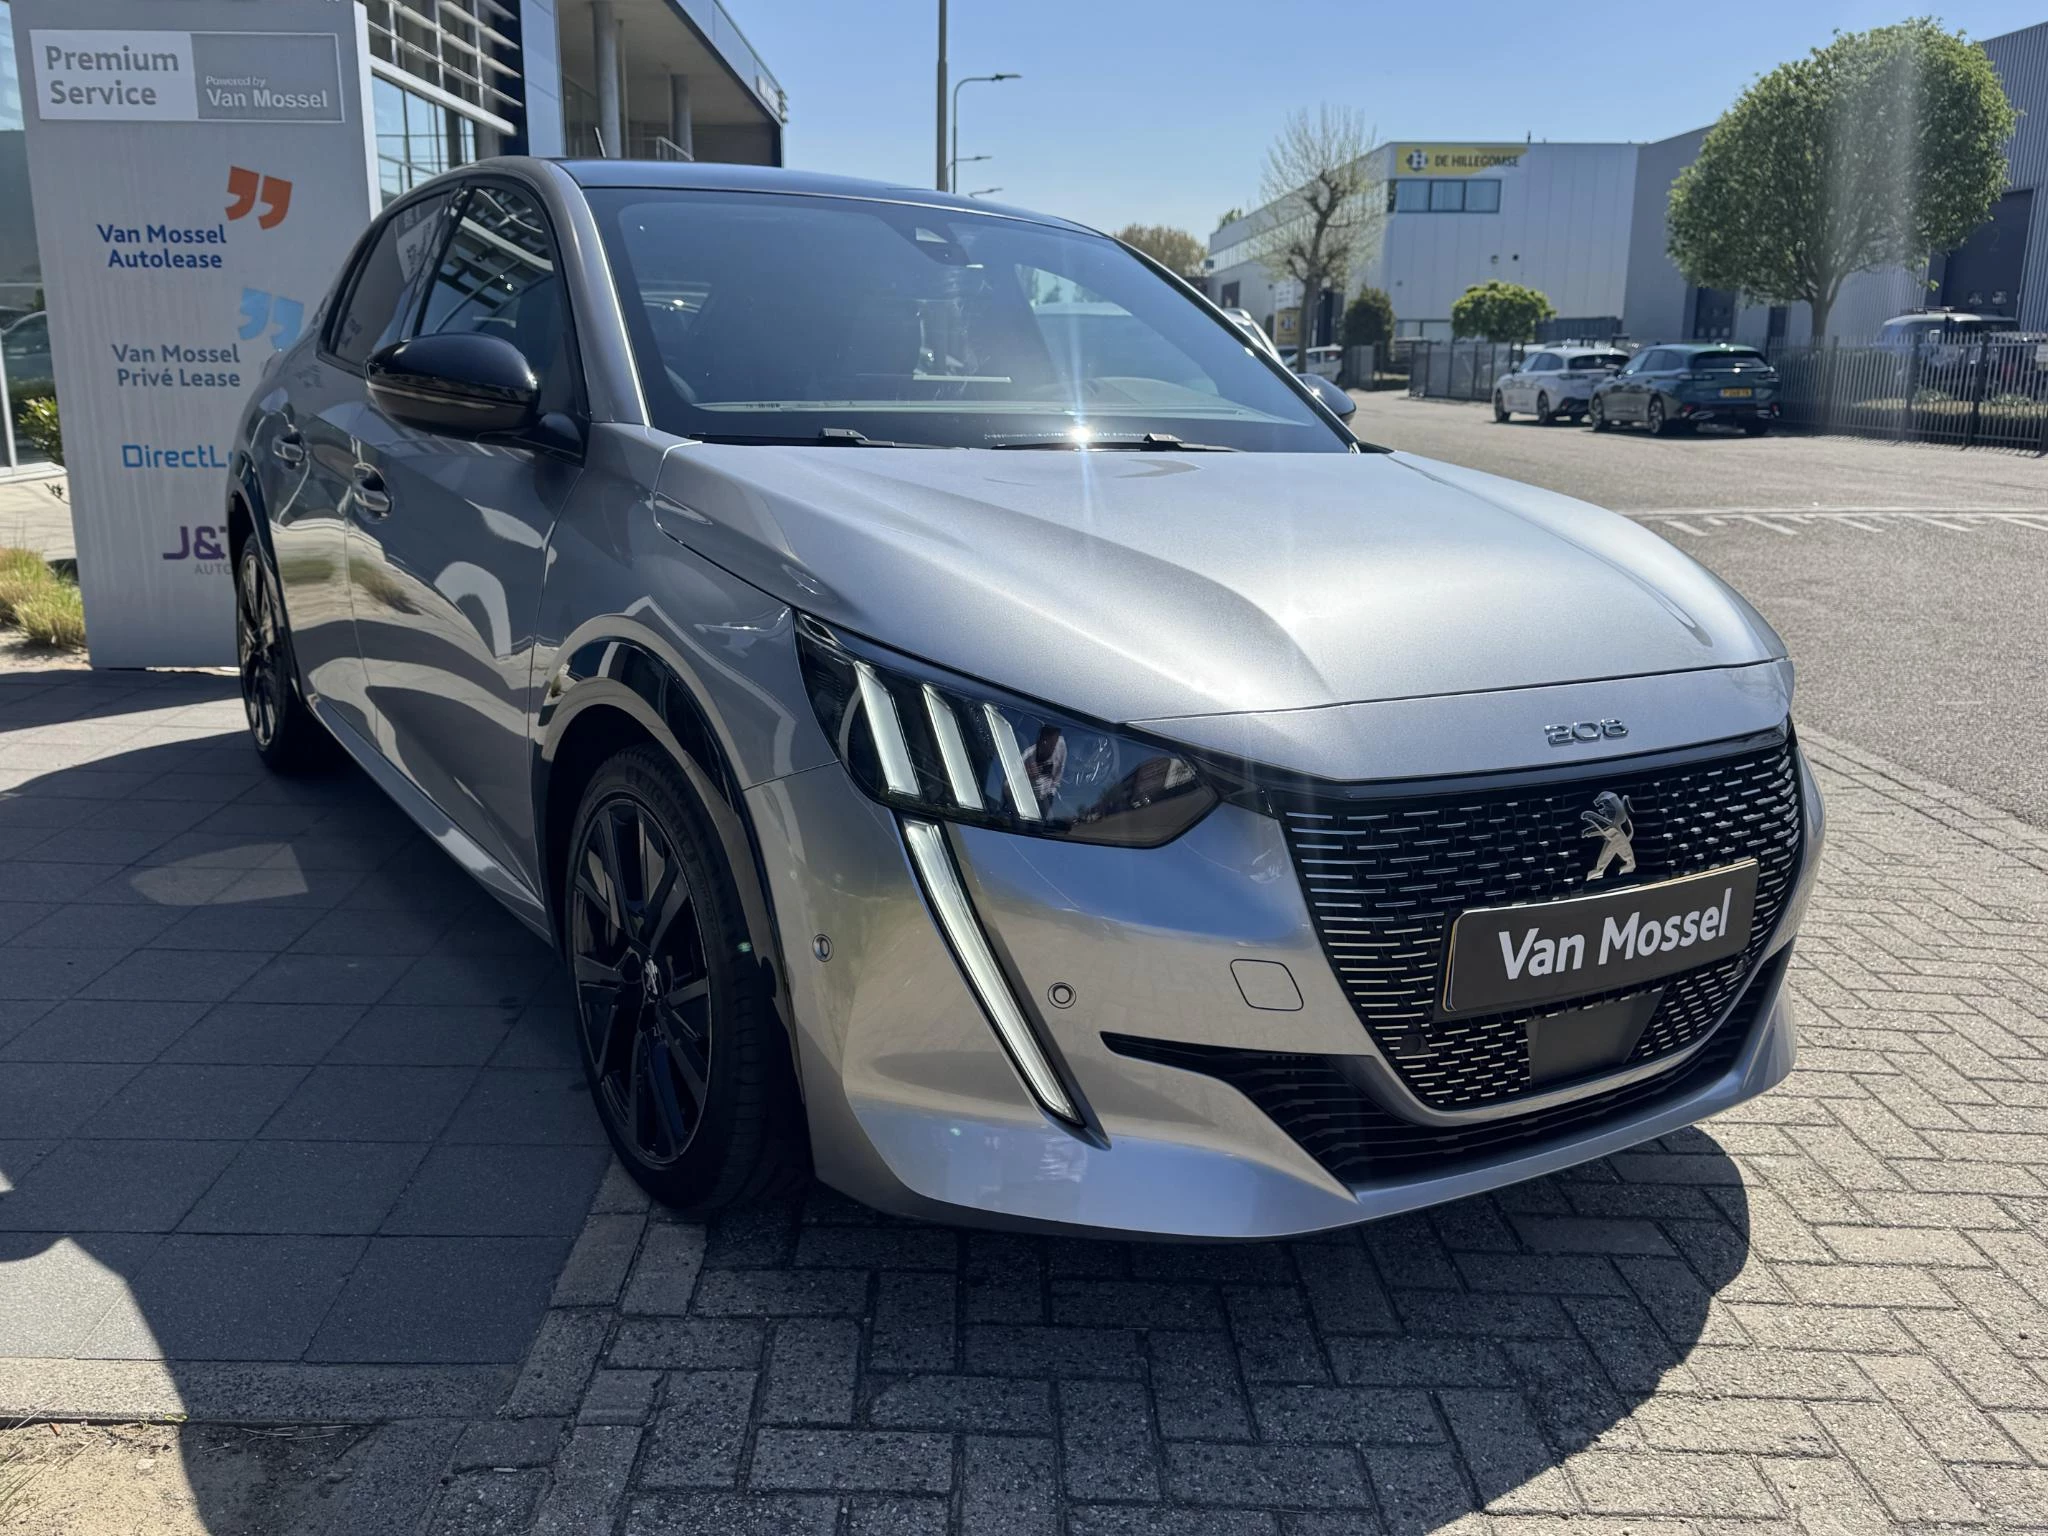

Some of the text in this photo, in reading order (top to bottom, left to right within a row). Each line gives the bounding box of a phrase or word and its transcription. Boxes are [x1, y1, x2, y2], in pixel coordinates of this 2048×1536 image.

[46, 45, 179, 72] Premium
[206, 76, 266, 87] Powered by
[50, 80, 157, 106] Service
[206, 88, 328, 108] Van Mossel
[1434, 155, 1519, 168] DE HILLEGOMSE
[97, 224, 226, 244] Van Mossel
[108, 249, 222, 269] Autolease
[112, 344, 240, 363] Van Mossel
[117, 368, 240, 387] Privé Lease
[1544, 719, 1629, 747] 208
[1499, 888, 1732, 980] Van Mossel
